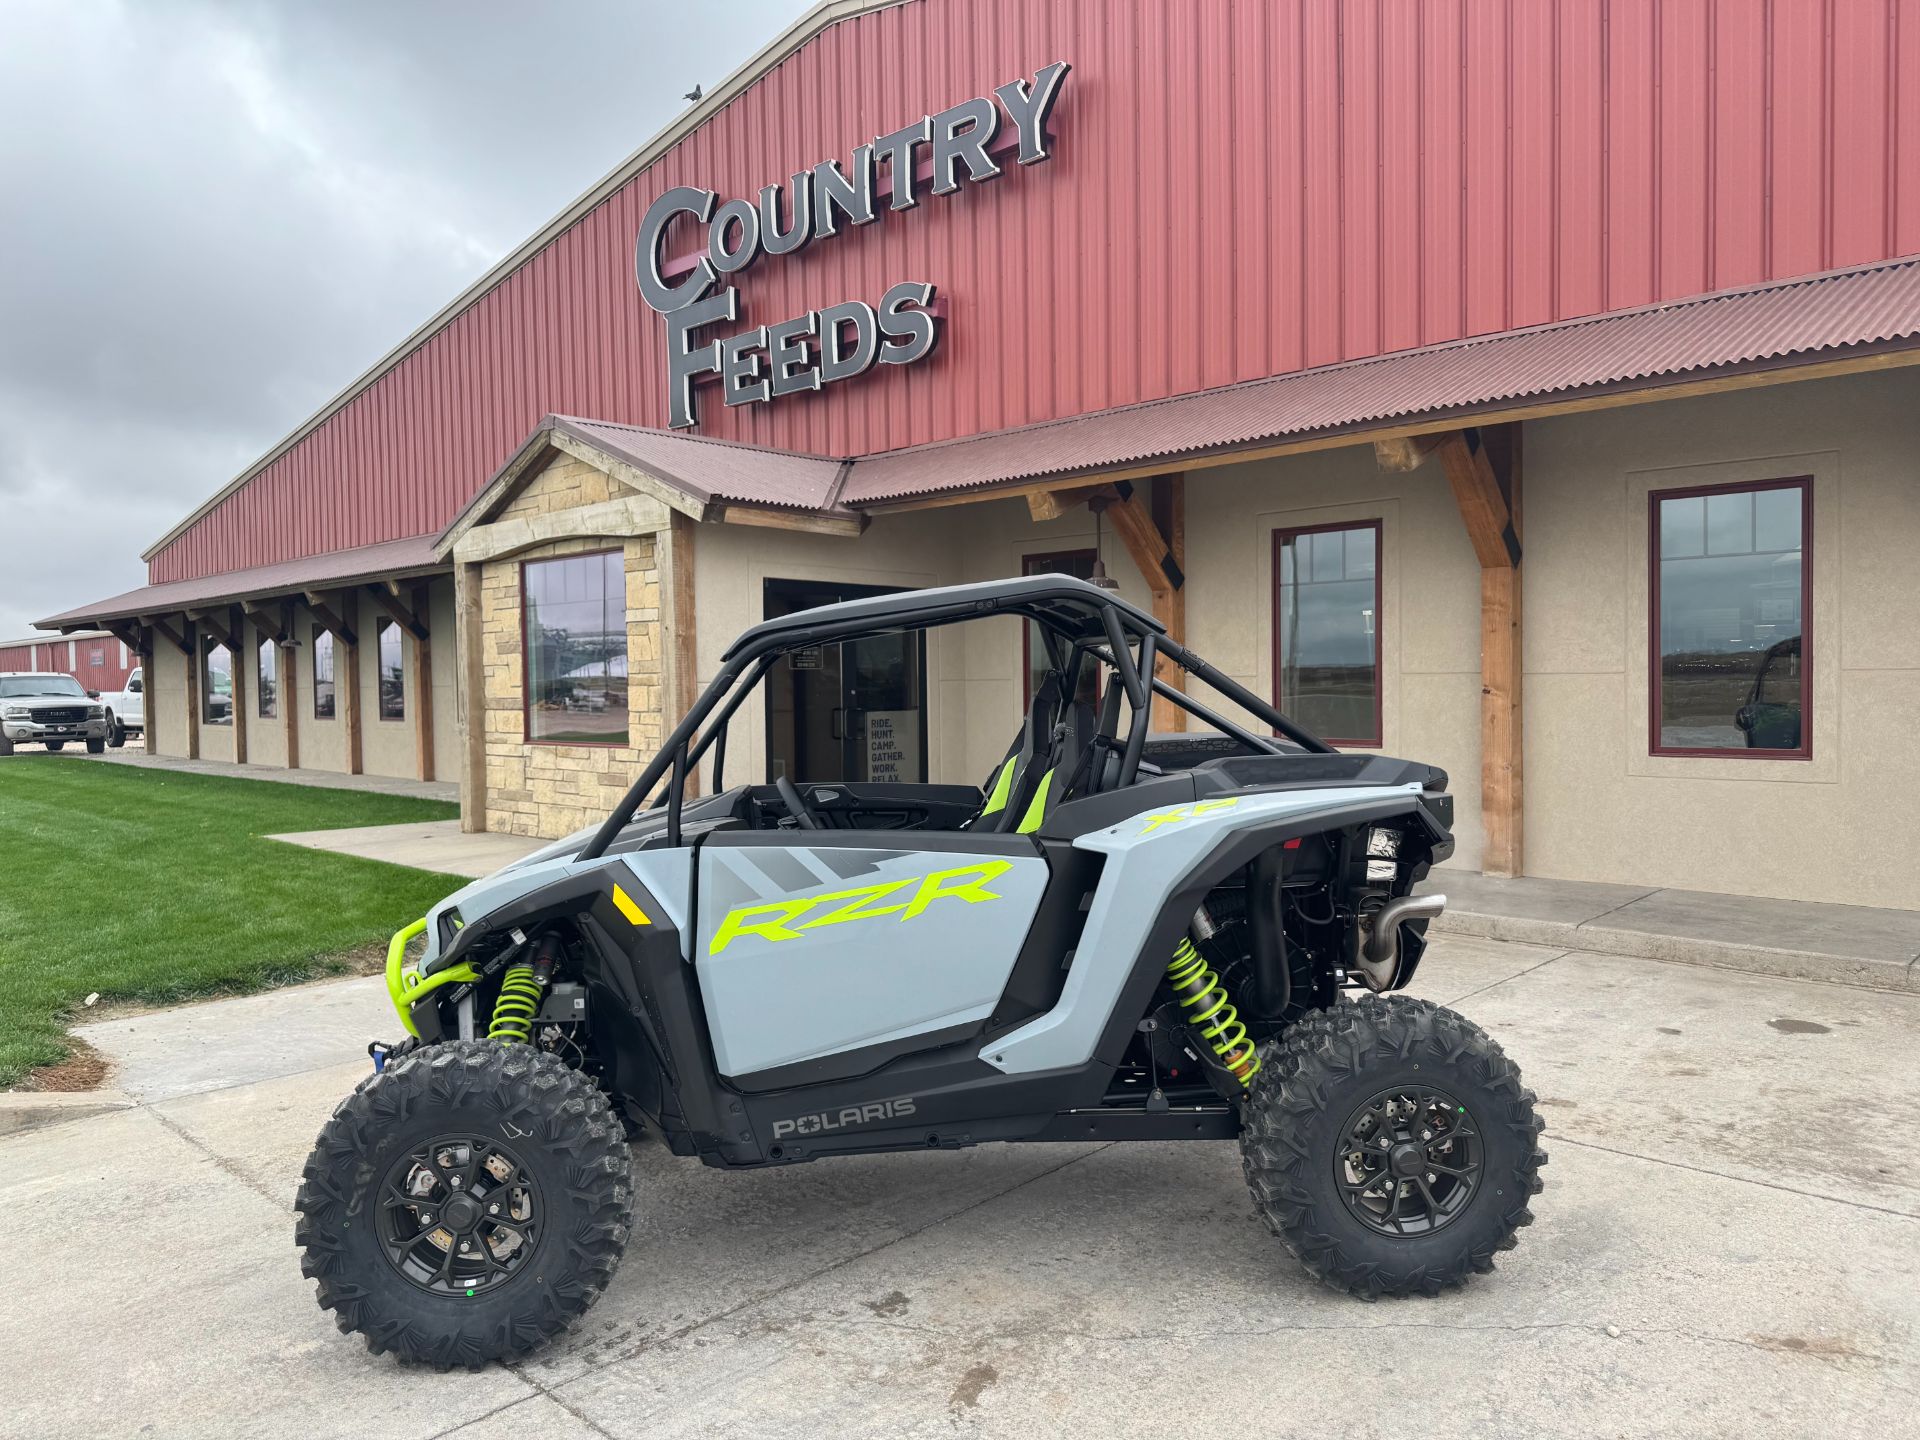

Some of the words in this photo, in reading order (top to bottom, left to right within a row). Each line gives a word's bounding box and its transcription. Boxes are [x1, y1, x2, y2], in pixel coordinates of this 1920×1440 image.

[635, 61, 1069, 313] COUNTRY
[664, 282, 936, 429] FEEDS
[871, 719, 892, 728] RIDE.
[871, 730, 895, 739] HUNT.
[871, 741, 897, 751] CAMP.
[871, 752, 905, 761] GATHER.
[871, 763, 898, 773] WORK.
[1137, 797, 1239, 837] XP
[709, 859, 1014, 956] RZR
[772, 1098, 916, 1139] POLARIS
